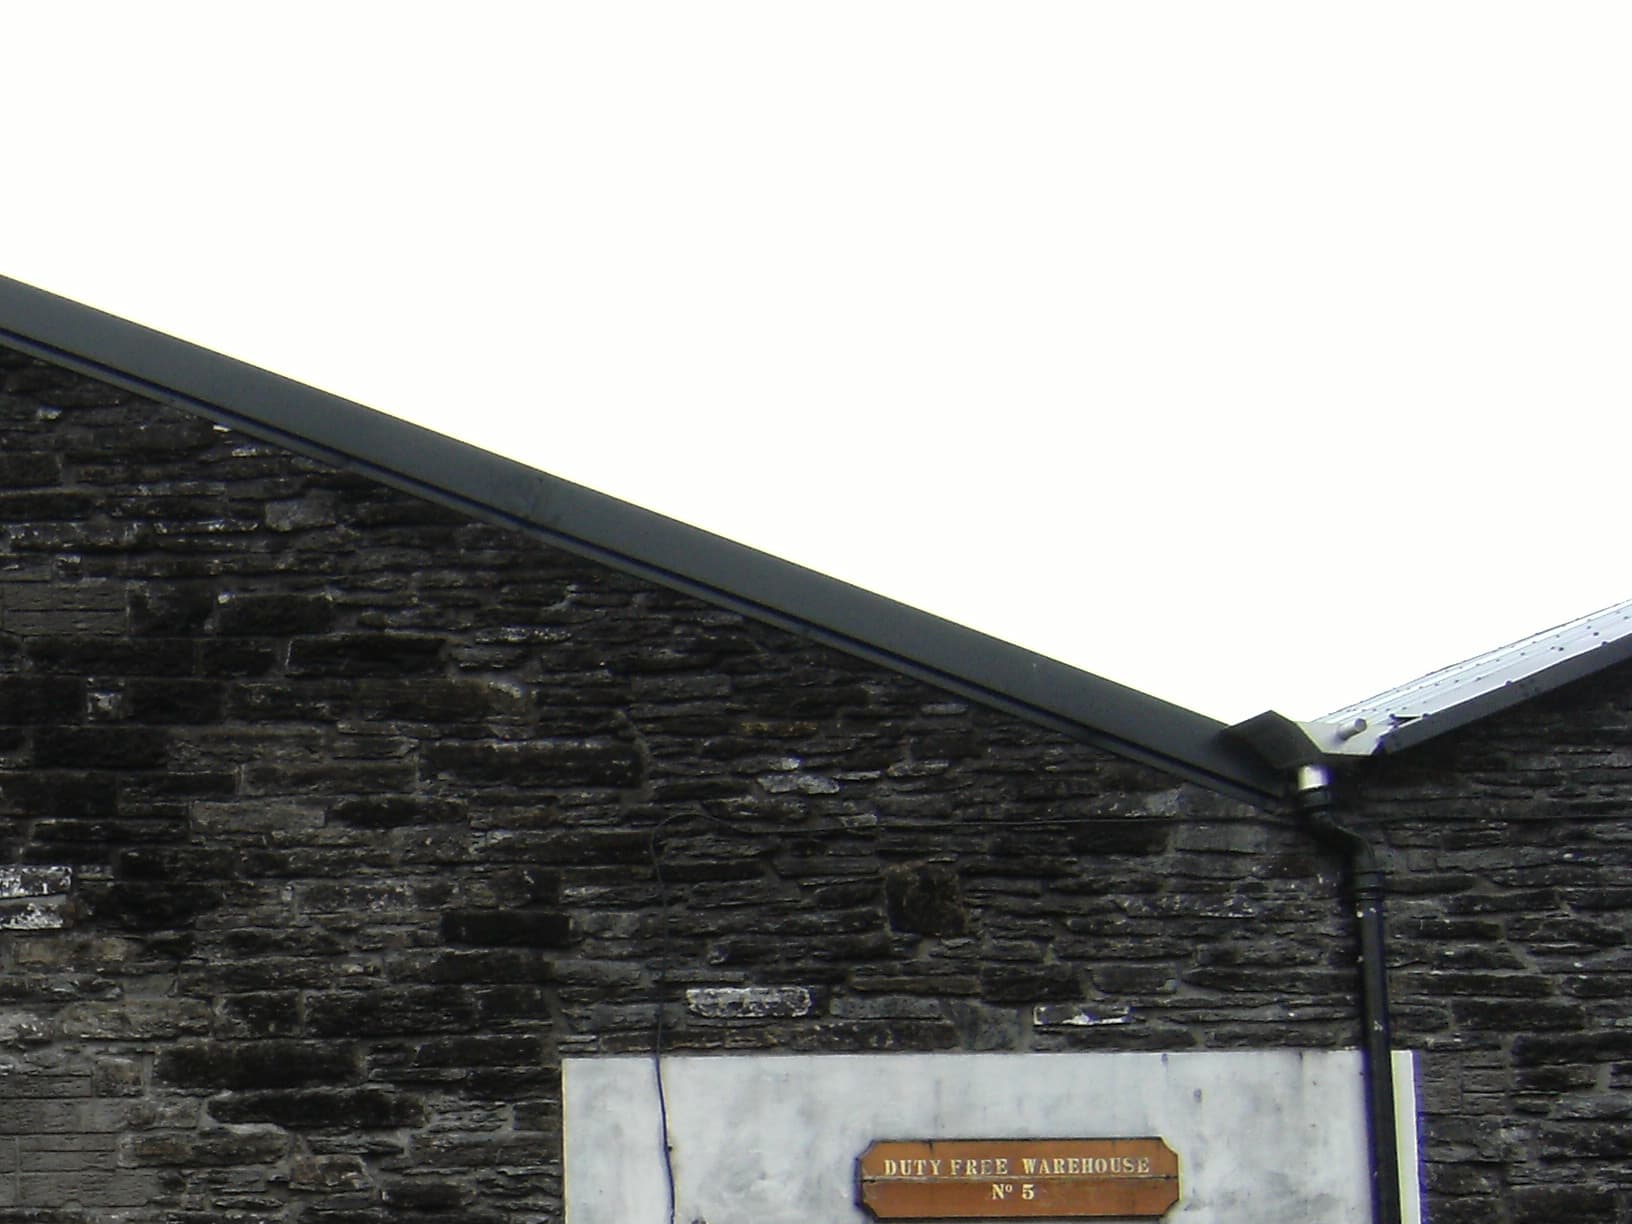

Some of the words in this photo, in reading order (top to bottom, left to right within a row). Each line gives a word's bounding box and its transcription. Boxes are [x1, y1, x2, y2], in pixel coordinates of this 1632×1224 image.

[884, 1159, 941, 1176] DUTY
[951, 1158, 1009, 1175] FREE
[1023, 1157, 1150, 1174] WAREHOUSE
[1022, 1184, 1035, 1200] 5
